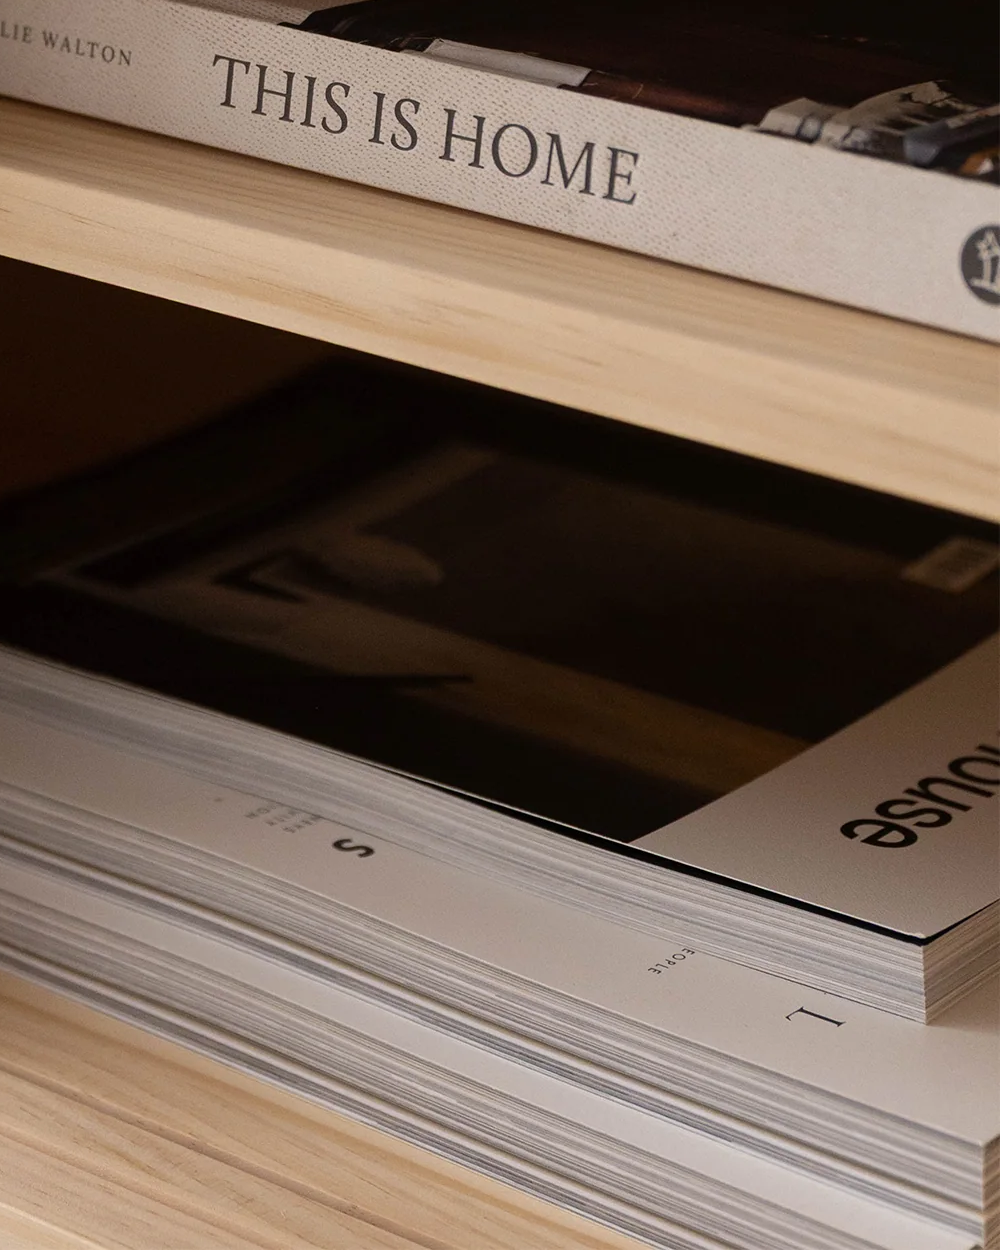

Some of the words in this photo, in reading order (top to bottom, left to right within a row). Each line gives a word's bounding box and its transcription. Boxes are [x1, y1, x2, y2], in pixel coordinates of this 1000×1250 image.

[42, 29, 132, 67] WALTON
[212, 54, 350, 134] THIS
[368, 91, 421, 151] IS
[438, 108, 640, 205] HOME
[839, 743, 1000, 848] ouse
[647, 947, 696, 975] EOPLE
